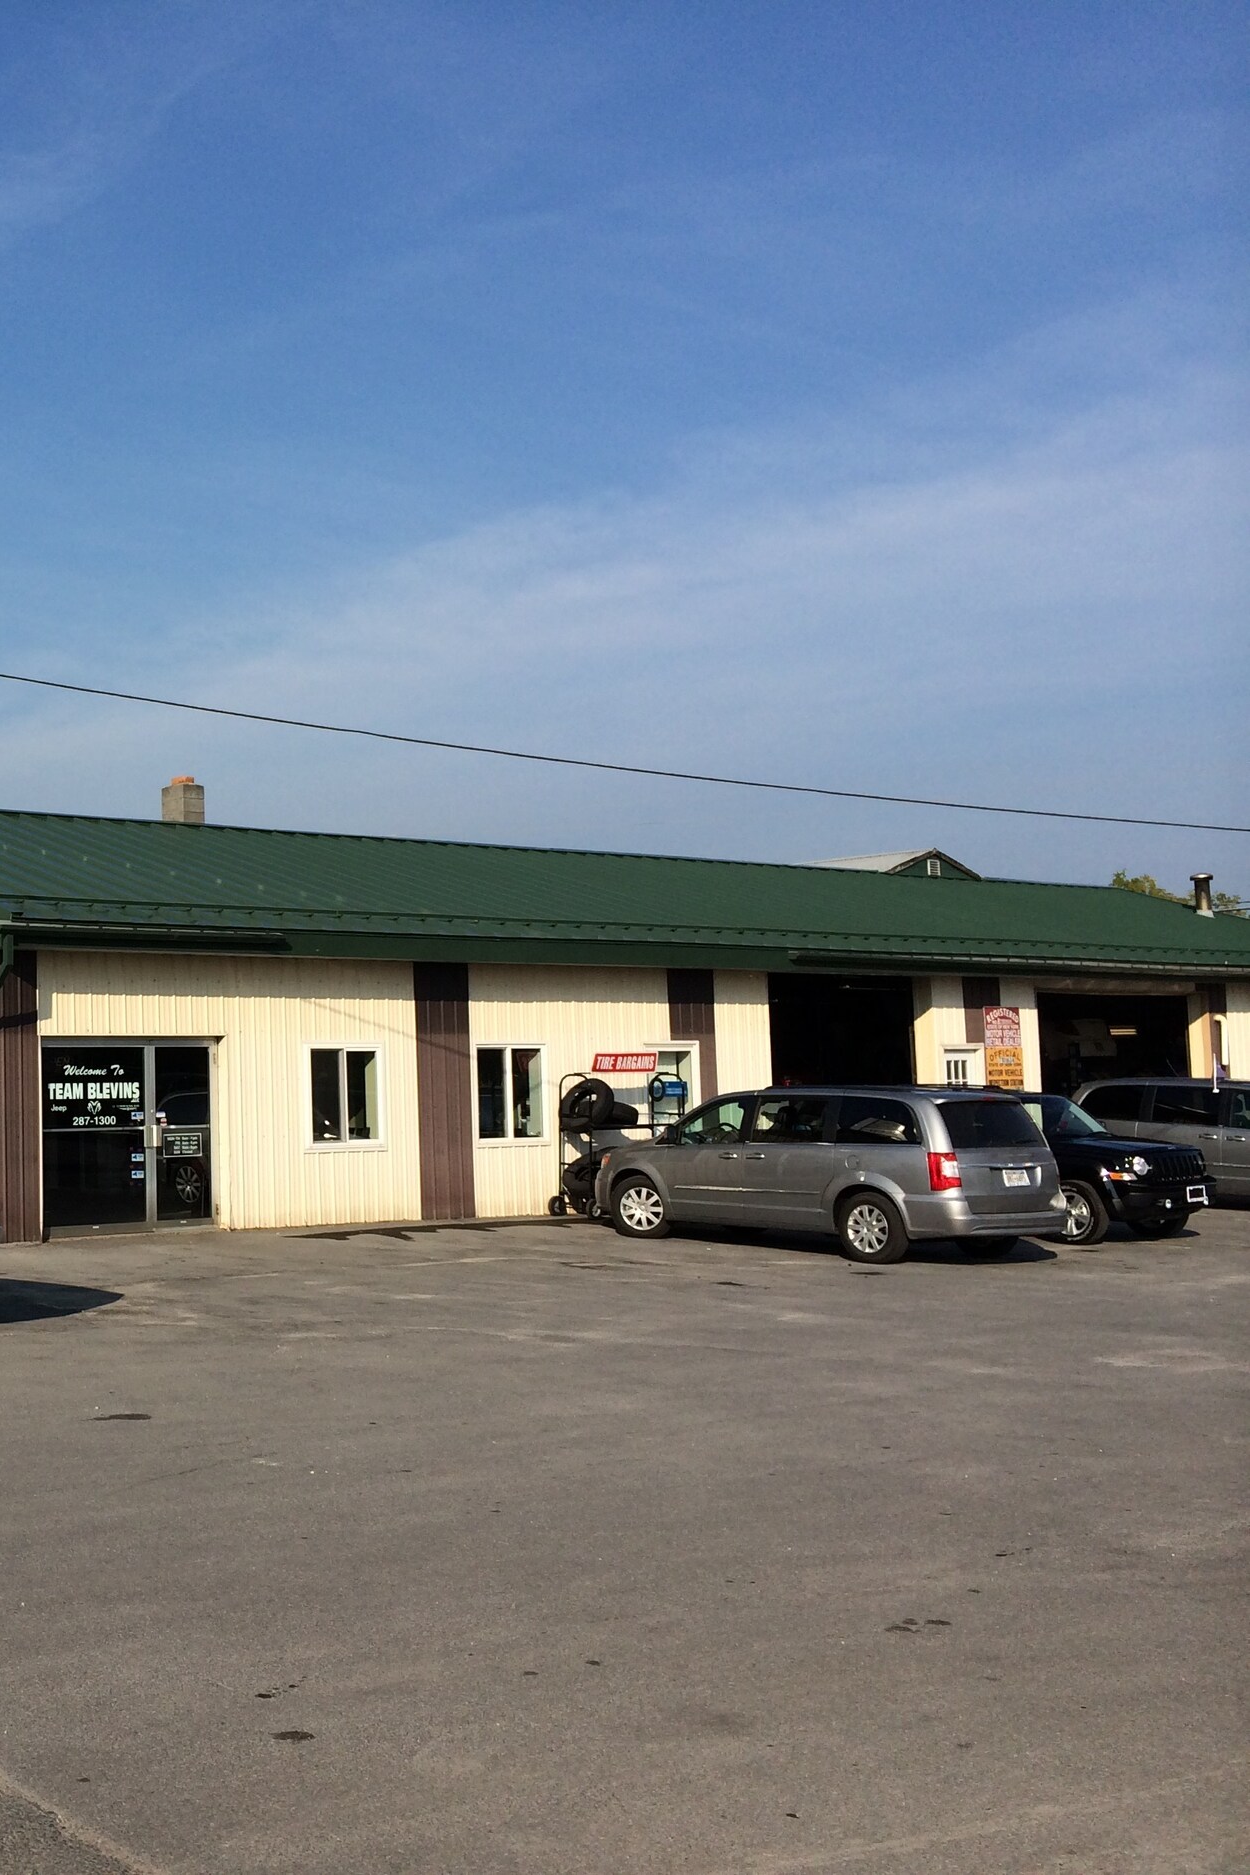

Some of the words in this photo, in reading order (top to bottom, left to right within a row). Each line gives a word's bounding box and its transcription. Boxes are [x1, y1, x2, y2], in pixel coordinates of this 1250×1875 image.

[990, 1050, 1021, 1062] OFFICIAL
[595, 1056, 615, 1070] TIRE
[616, 1055, 655, 1070] BARGAINS
[63, 1064, 107, 1076] Welcome
[110, 1064, 124, 1076] To
[48, 1082, 84, 1100] TEAM
[87, 1082, 140, 1099] BLEVINS
[50, 1104, 67, 1112] Jeep
[72, 1116, 117, 1126] 287-1300
